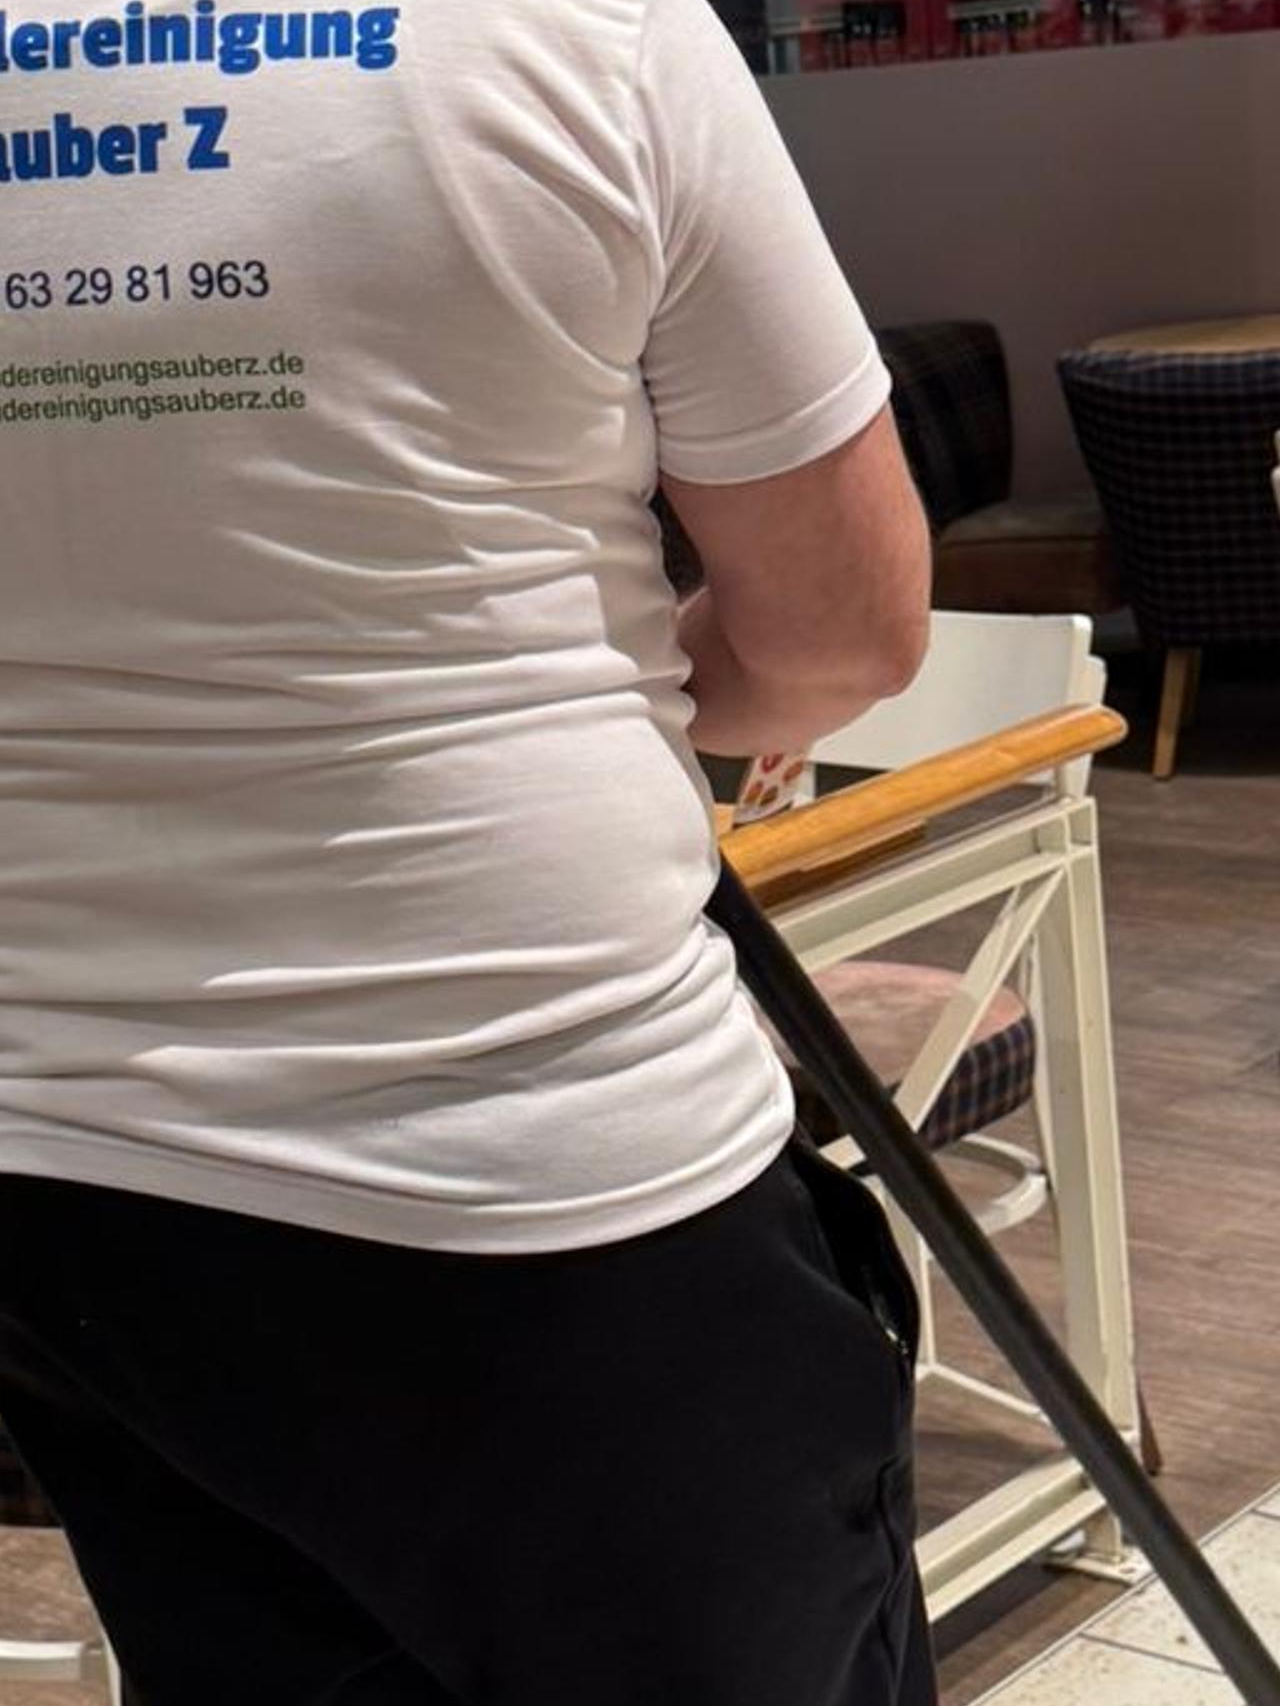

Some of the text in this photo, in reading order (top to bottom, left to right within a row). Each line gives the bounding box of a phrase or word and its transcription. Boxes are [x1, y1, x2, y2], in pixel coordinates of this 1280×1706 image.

[183, 106, 231, 170] Z
[5, 271, 53, 310] 63
[65, 267, 113, 306] 29
[126, 264, 170, 302] 81
[188, 260, 270, 300] 963
